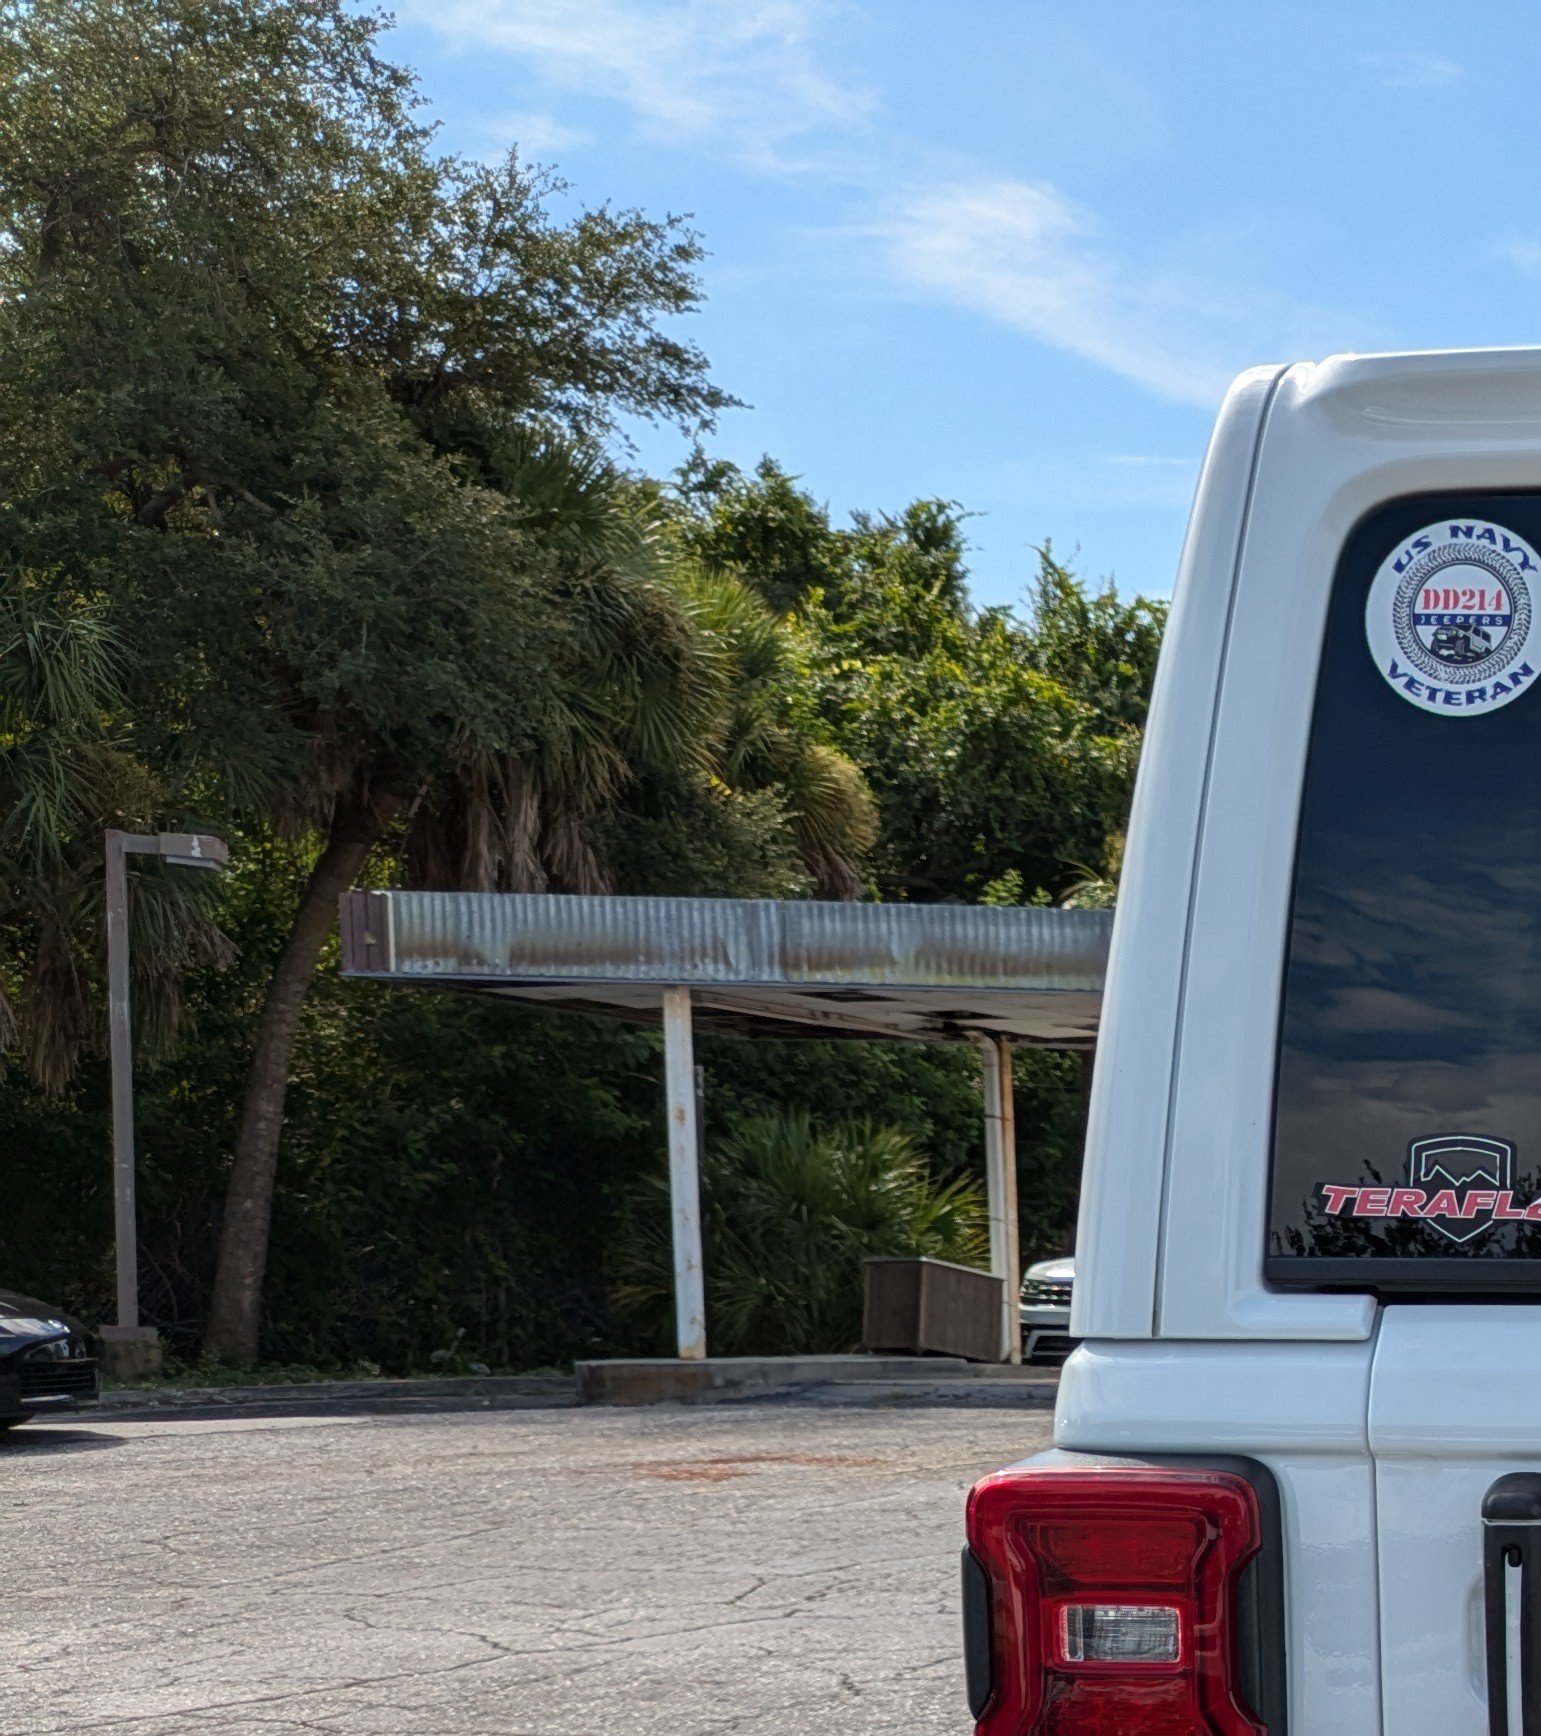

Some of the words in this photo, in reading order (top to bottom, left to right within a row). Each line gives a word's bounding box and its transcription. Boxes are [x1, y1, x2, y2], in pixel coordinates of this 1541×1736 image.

[1392, 534, 1433, 575] US
[1448, 524, 1539, 574] NAVY
[1421, 587, 1504, 612] DD214
[1419, 615, 1504, 626] JEEPERS
[1387, 657, 1536, 707] VETERAN
